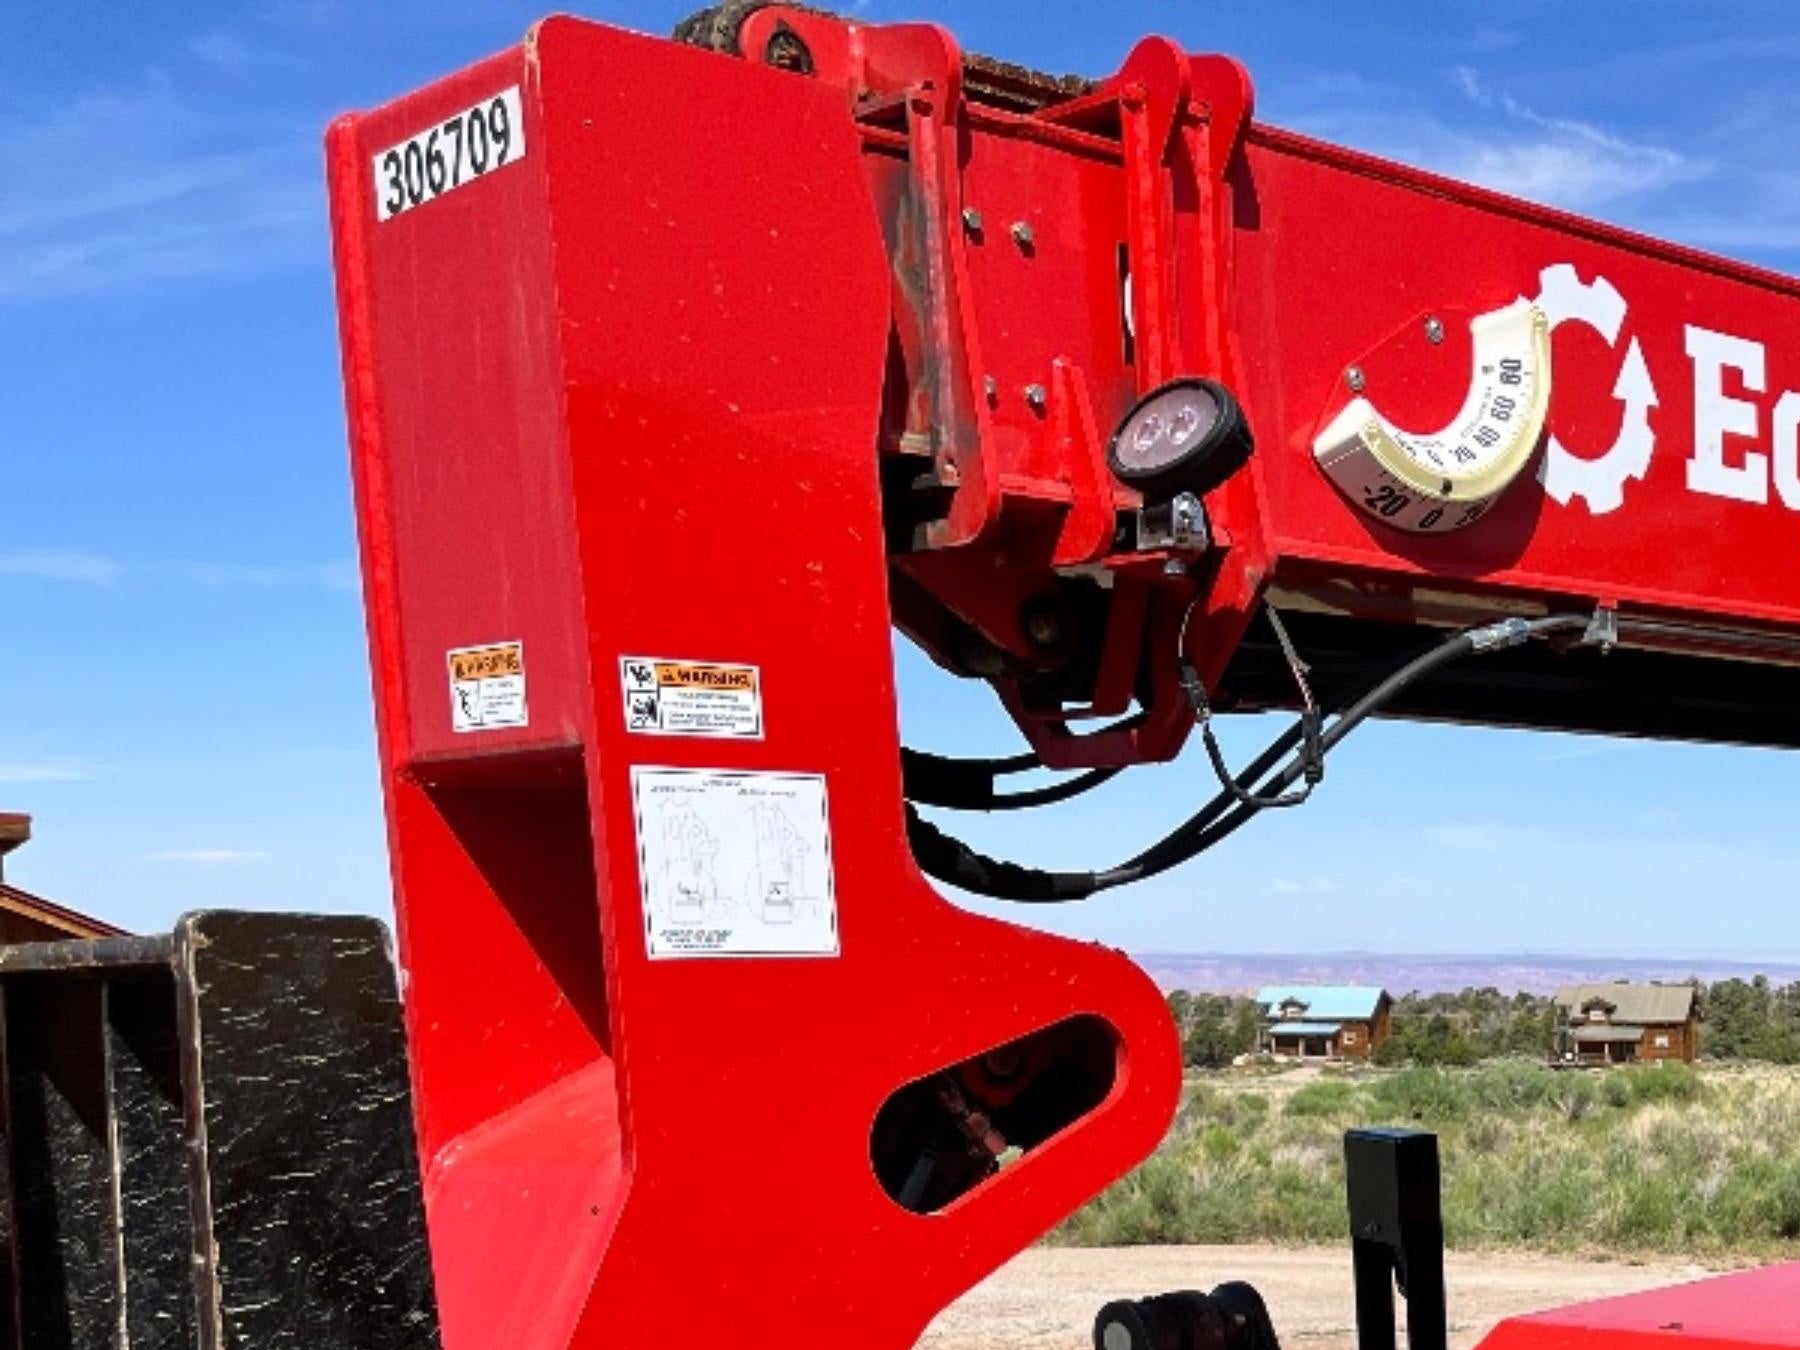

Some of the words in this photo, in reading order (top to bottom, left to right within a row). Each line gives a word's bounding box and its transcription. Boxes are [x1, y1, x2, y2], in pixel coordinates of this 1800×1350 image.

[384, 96, 511, 215] 306709
[1500, 358, 1521, 385] 80
[1491, 395, 1515, 421] 60
[1364, 485, 1410, 516] -20
